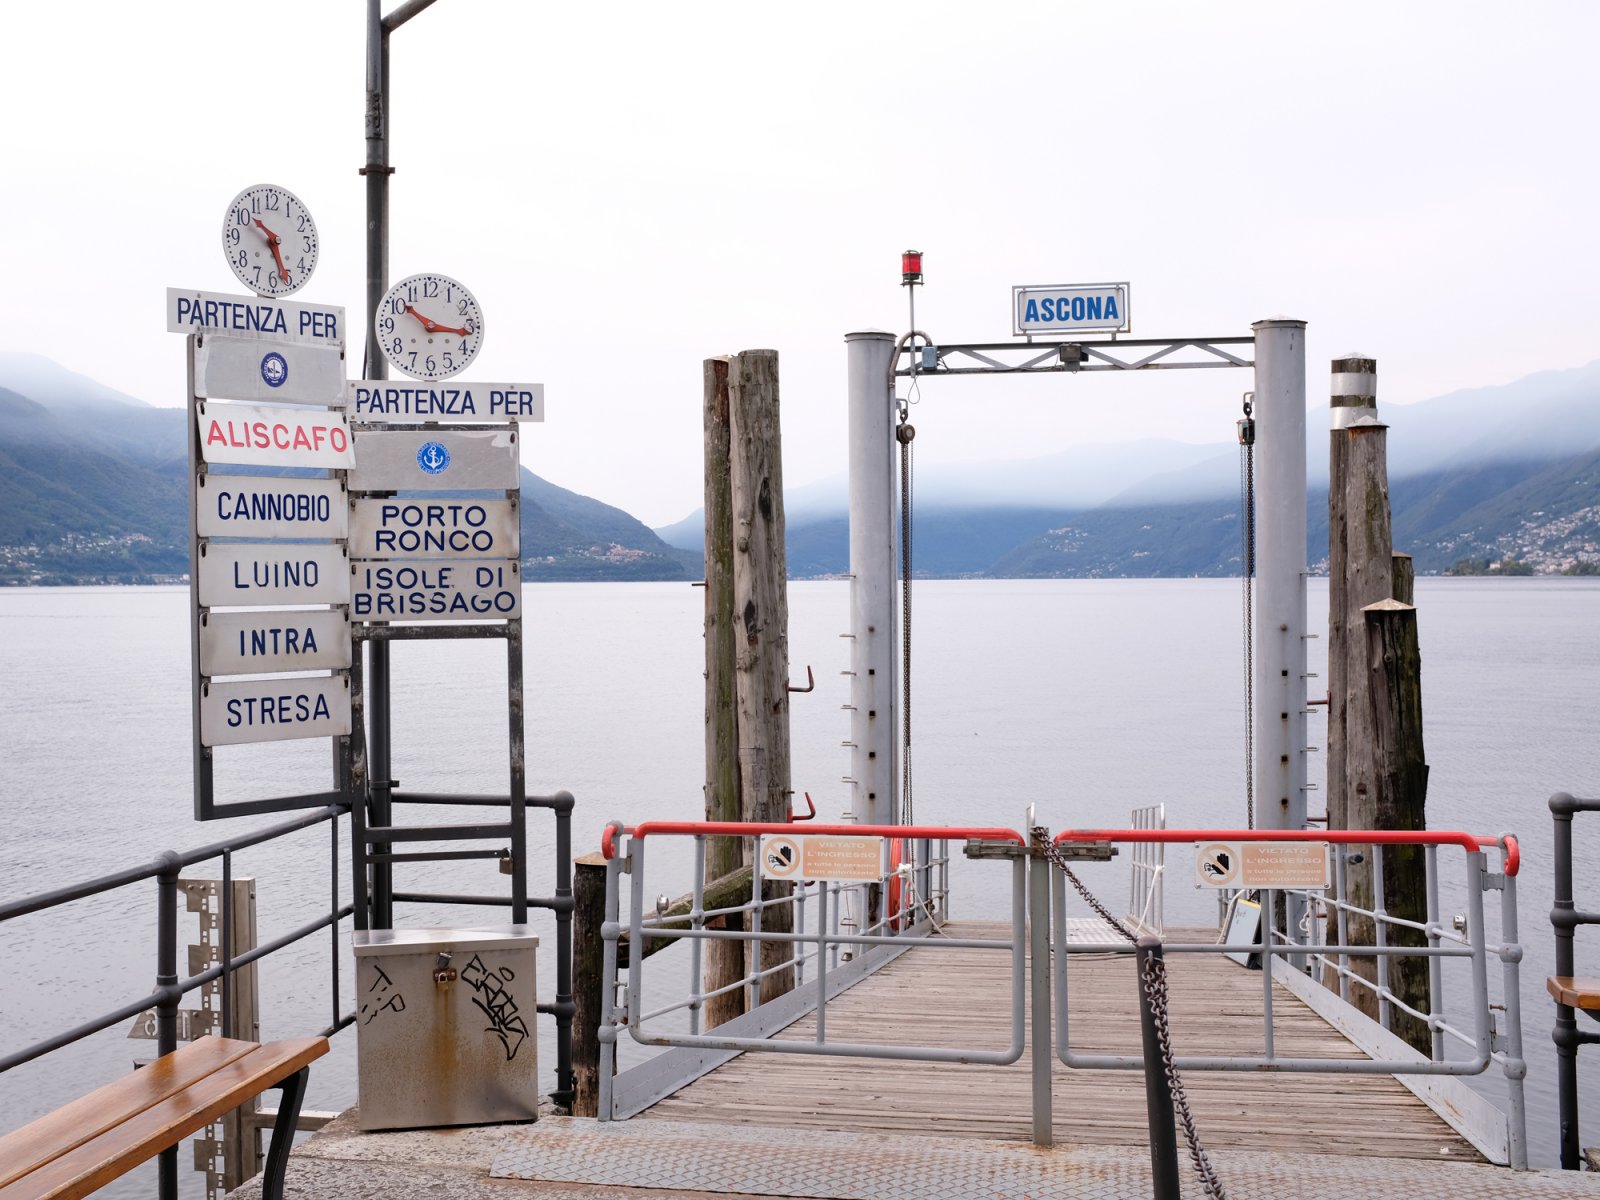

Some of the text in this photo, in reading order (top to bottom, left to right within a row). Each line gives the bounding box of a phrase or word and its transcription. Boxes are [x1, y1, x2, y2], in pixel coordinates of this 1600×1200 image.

[251, 197, 261, 214] 11
[265, 193, 279, 211] 12
[286, 201, 291, 218] 1
[236, 208, 250, 226] 10
[297, 215, 306, 233] 2
[231, 228, 240, 246] 9
[303, 236, 311, 253] 3
[239, 250, 248, 268] 8
[297, 257, 306, 274] 4
[253, 266, 262, 283] 7
[268, 271, 278, 288] 6
[407, 285, 418, 302] 11
[423, 280, 439, 298] 12
[446, 286, 451, 303] 1
[391, 298, 406, 315] 10
[459, 299, 468, 316] 2
[1024, 296, 1119, 323] ASCONA
[177, 297, 337, 339] PARTENZA PER
[385, 317, 395, 334] 9
[465, 318, 475, 335] 3
[393, 337, 403, 354] 8
[458, 339, 468, 355] 4
[408, 352, 418, 368] 7
[425, 355, 436, 371] 6
[442, 352, 453, 369] 5
[356, 388, 533, 415] PARTENZA PER
[207, 419, 347, 453] ALISCAFO
[218, 492, 330, 522] CANNOBIO
[382, 505, 486, 527] PORTO
[375, 530, 493, 551] RONCO
[234, 560, 319, 588] LUINO
[366, 567, 503, 590] ISOLE DI
[354, 591, 516, 615] BRISSAGO
[240, 627, 318, 656] INTRA
[227, 693, 331, 728] STRESA
